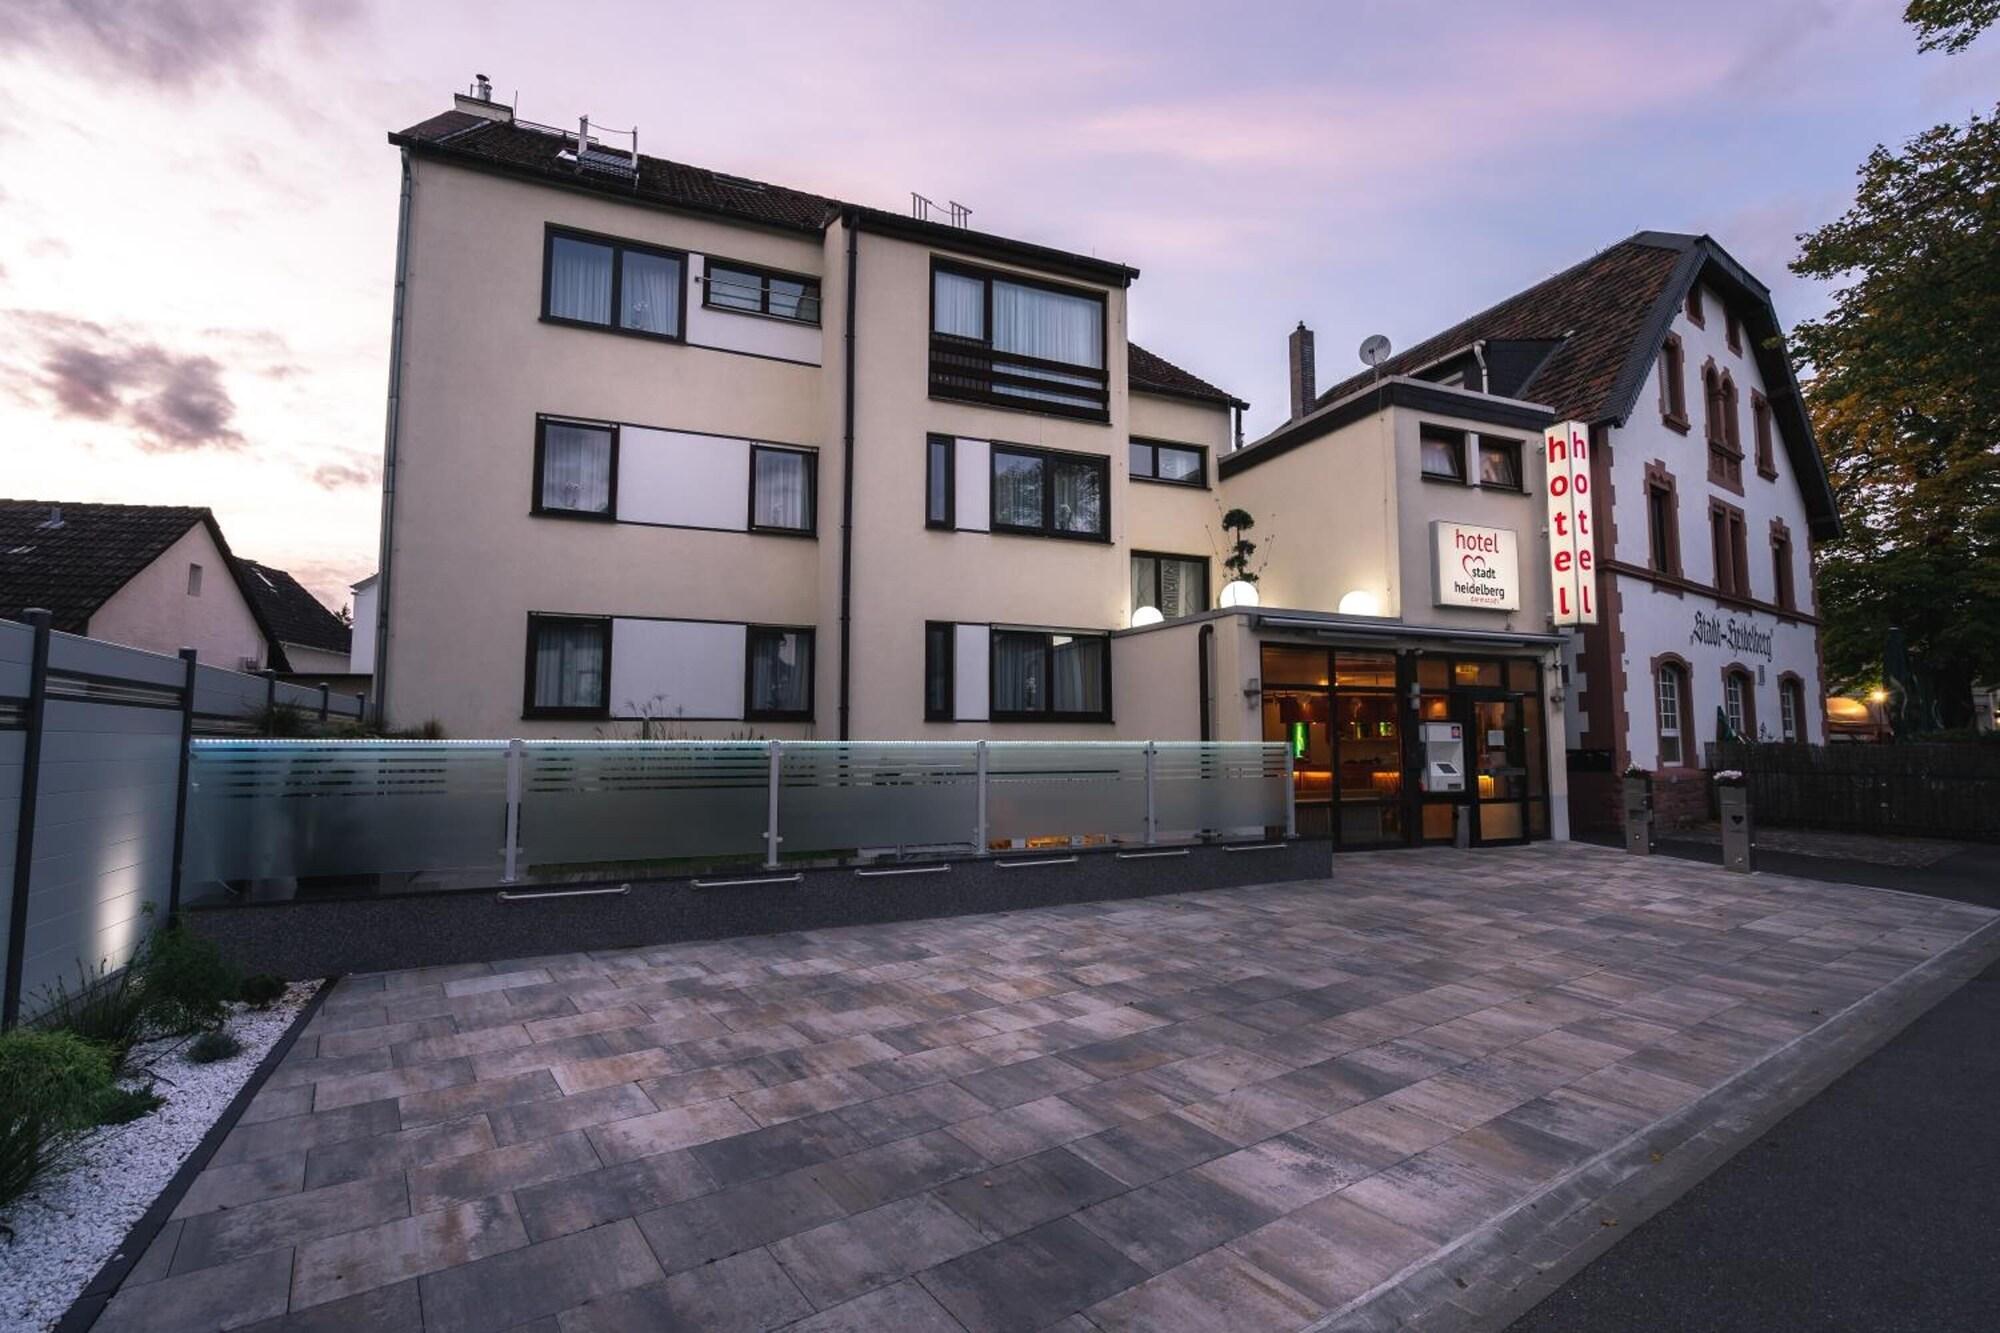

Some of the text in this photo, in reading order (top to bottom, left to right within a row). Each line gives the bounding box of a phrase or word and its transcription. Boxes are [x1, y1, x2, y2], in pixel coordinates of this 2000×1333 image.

[1548, 436, 1571, 615] hotel
[1573, 431, 1592, 614] hotel
[1455, 528, 1499, 554] hotel
[1472, 567, 1496, 579] stadt
[1454, 581, 1505, 600] heidelberg
